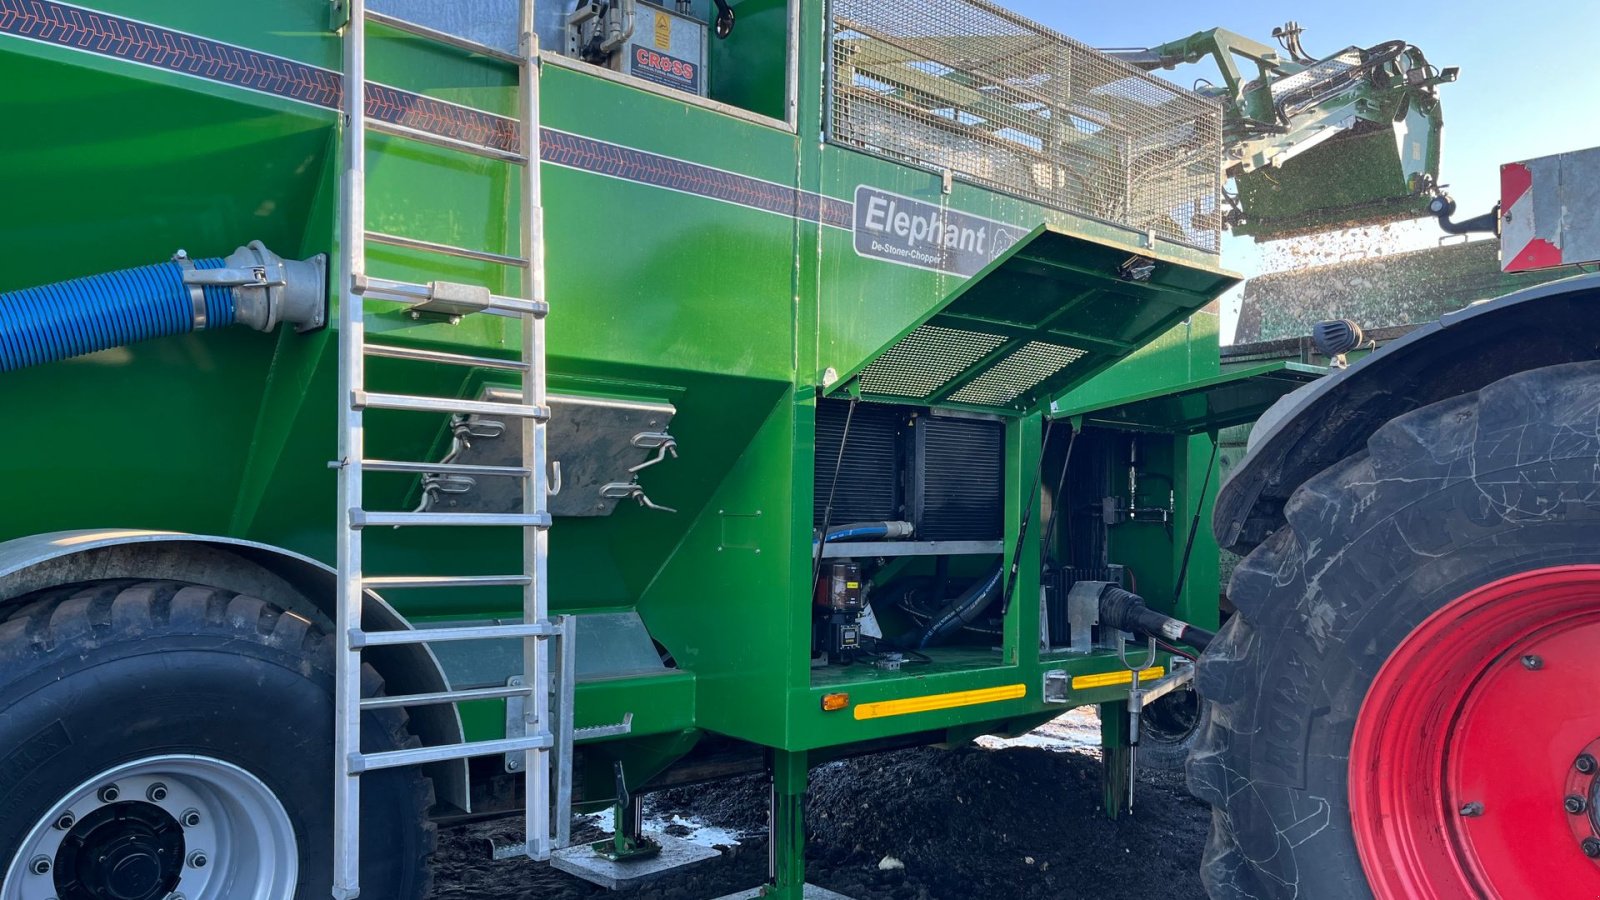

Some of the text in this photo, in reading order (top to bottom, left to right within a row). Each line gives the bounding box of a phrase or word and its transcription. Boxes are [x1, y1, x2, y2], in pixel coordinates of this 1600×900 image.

[636, 48, 693, 79] CROSS
[865, 195, 986, 255] Elephant
[871, 240, 942, 264] De-Stoner-Chopper
